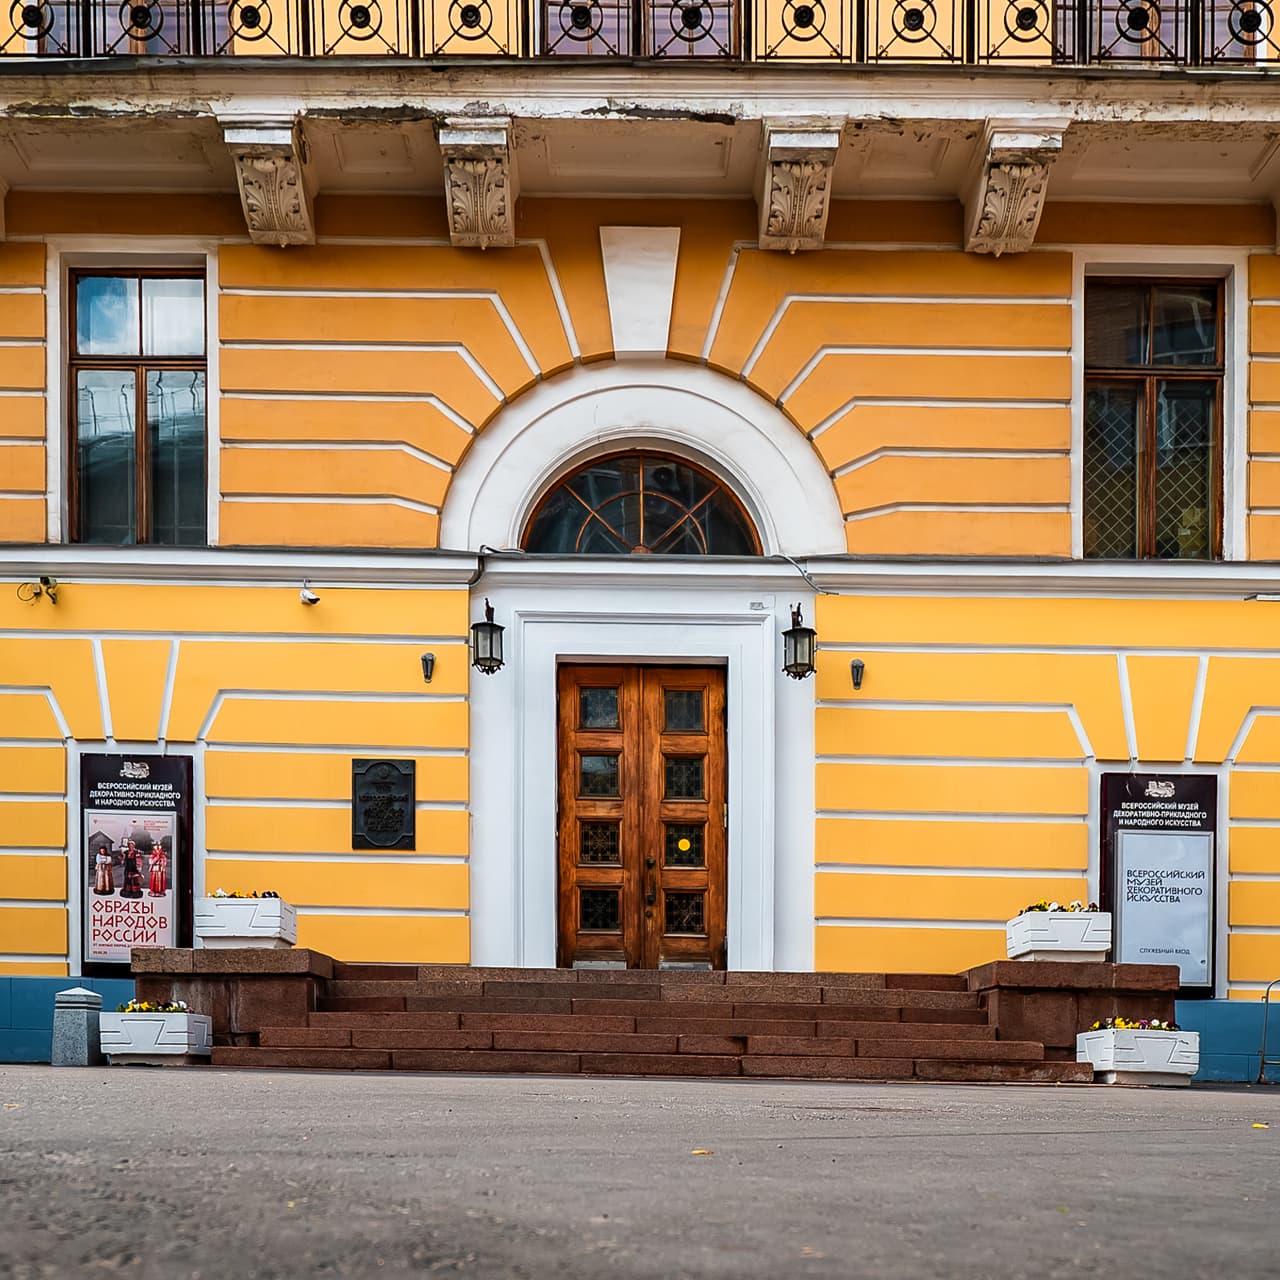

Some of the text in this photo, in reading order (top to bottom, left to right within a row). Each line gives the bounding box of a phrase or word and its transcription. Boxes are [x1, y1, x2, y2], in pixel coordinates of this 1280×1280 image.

[153, 783, 173, 791] МУЗЕЙ
[89, 790, 181, 799] ДЕКОРАТИВНО-ПРИКЛАДНОГО
[1113, 810, 1207, 819] ДЕКОРАТИВНО-ПРИКЛАДНОГО
[1127, 870, 1205, 879] ВСЕРОССИЙСКИЙ
[1127, 878, 1162, 886] МУЗЕЙ
[1127, 886, 1203, 895] ДЕКОРАТИВНОГО
[1127, 893, 1180, 903] ИСКУССТВА
[92, 900, 154, 914] ОБРАЗЫ
[92, 914, 168, 930] НАРОДОВ
[92, 929, 157, 943] РОССИИ
